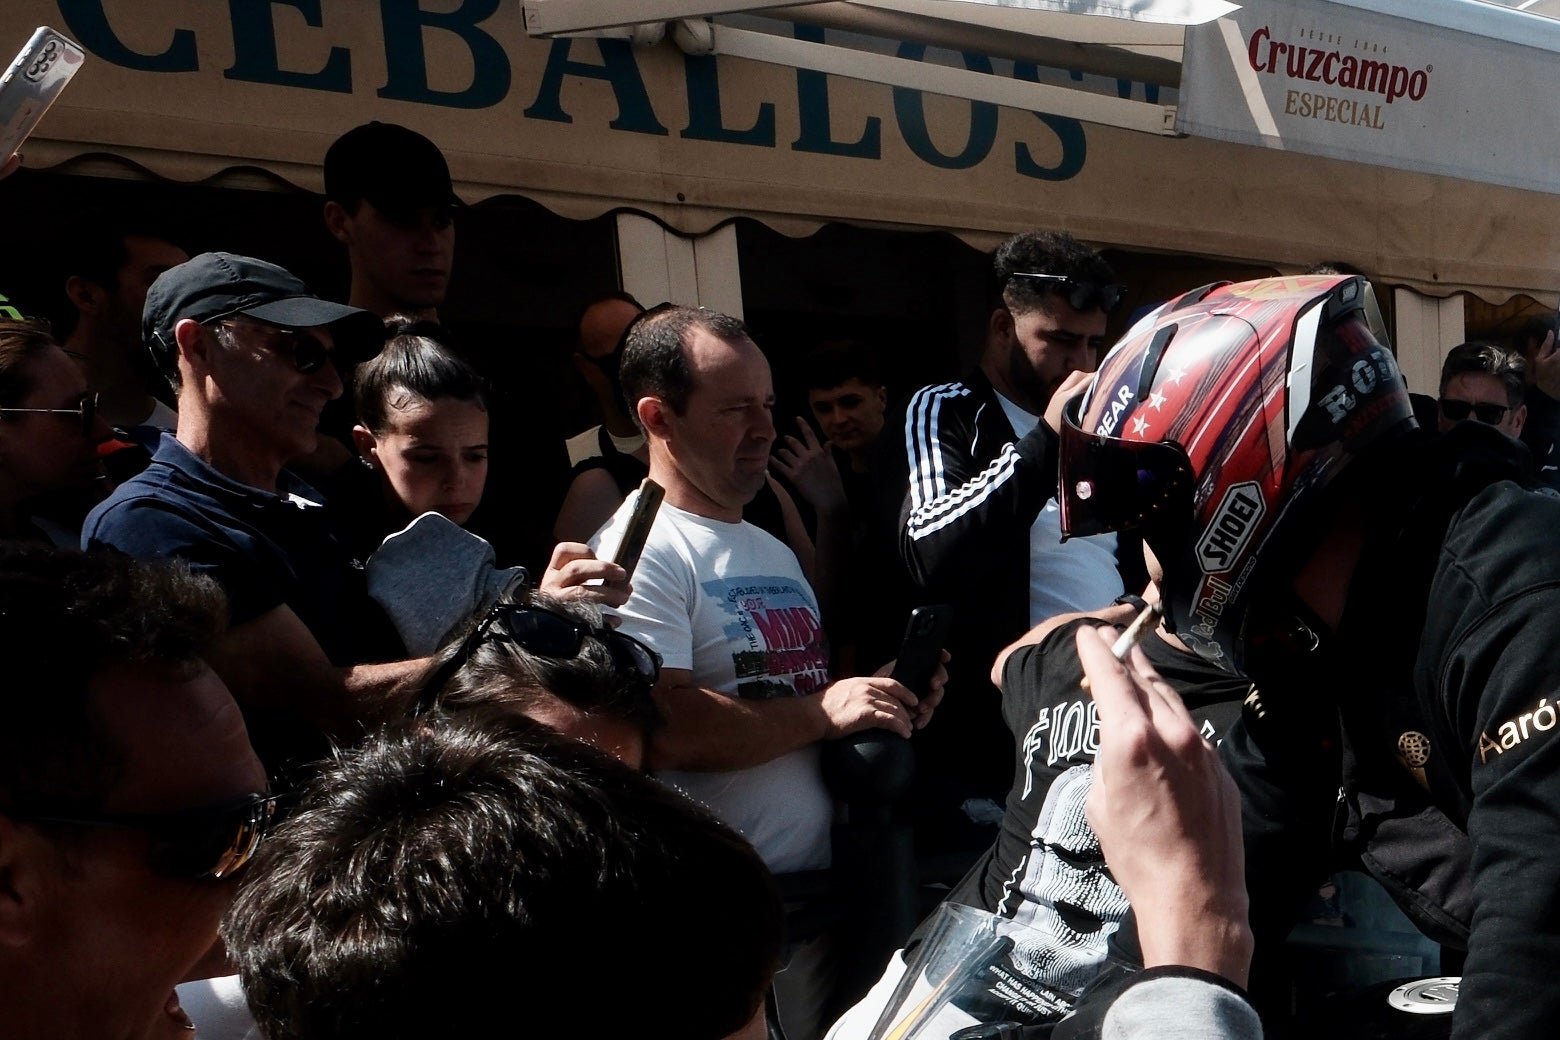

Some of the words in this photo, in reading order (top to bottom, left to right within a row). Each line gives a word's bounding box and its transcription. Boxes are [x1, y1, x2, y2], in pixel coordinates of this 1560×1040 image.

[57, 0, 1087, 181] CEBALLOS
[1249, 26, 1428, 105] Cruzcampo
[1284, 89, 1385, 130] ESPECIAL
[1203, 492, 1259, 567] SHOEI
[1200, 575, 1233, 616] Bull
[1006, 976, 1023, 991] HAS
